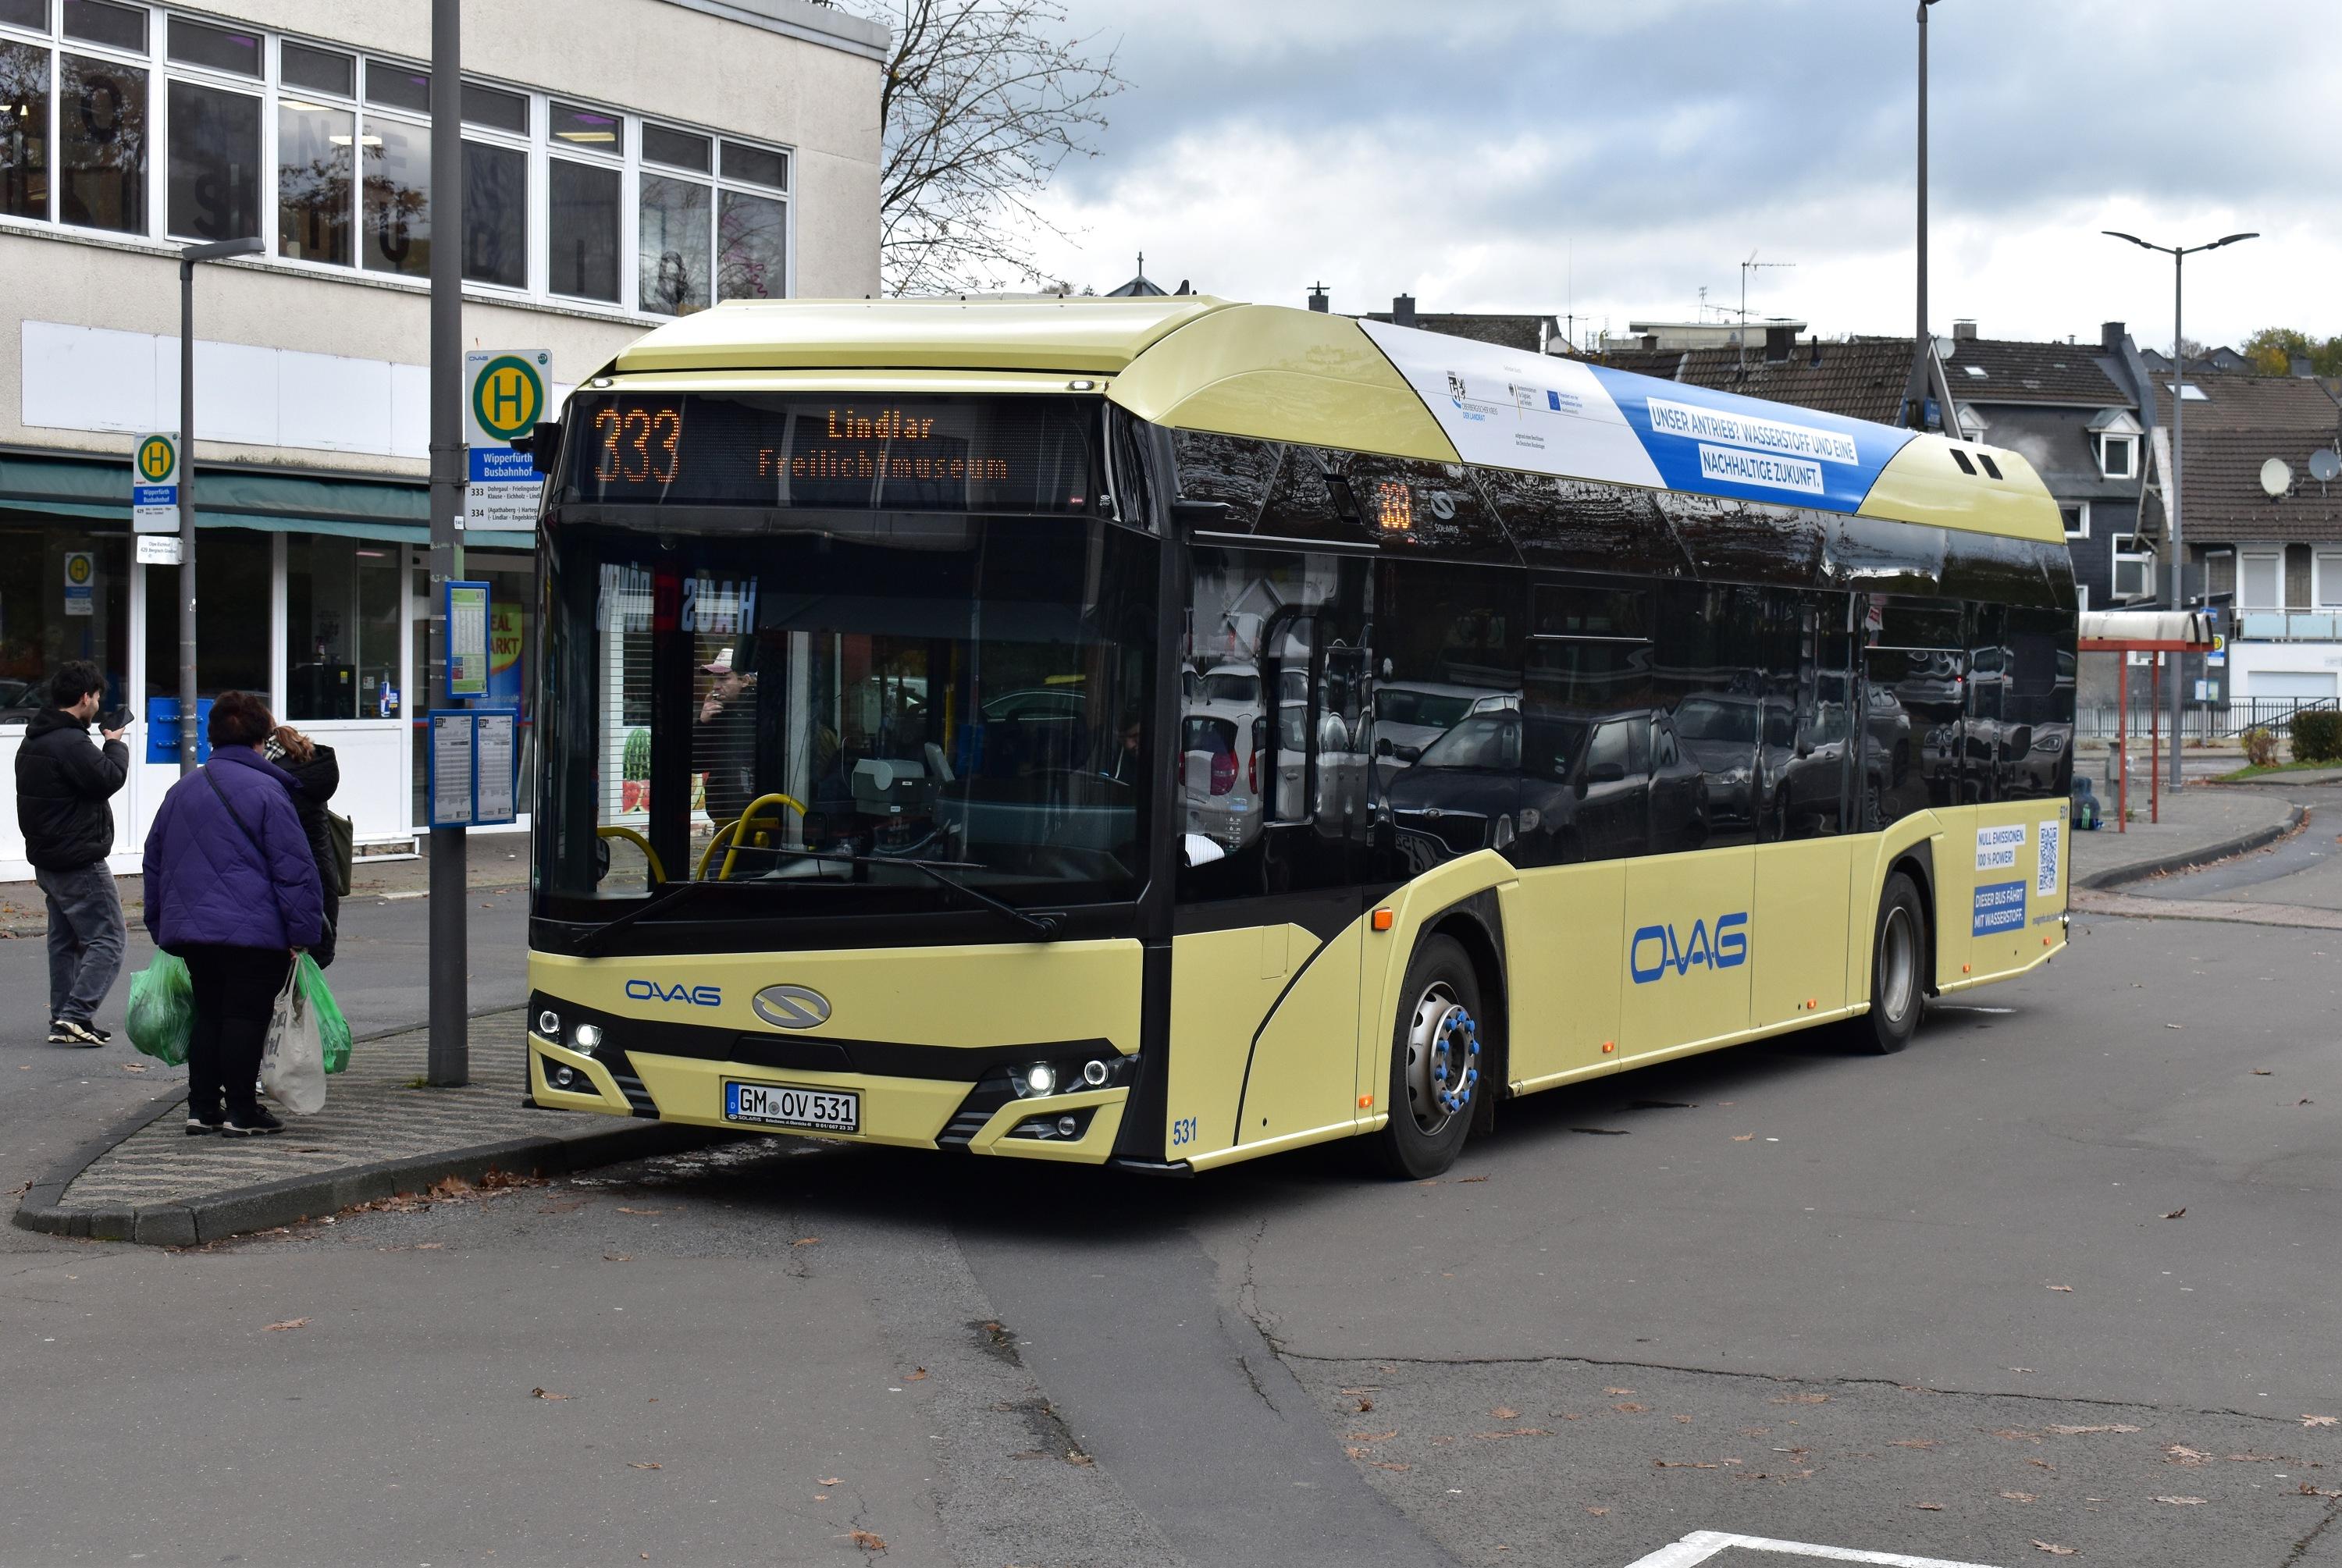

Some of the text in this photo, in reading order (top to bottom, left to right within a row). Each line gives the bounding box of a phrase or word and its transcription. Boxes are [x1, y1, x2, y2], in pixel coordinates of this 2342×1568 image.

[828, 410, 934, 439] Lindlar
[1651, 406, 1855, 460] UNSER ANTRIEB? WASSERSTOFF UND EINE
[596, 409, 679, 482] 333
[483, 453, 532, 466] Wipperfürth
[760, 450, 1007, 479] Freilichtmuseum
[1702, 451, 1821, 488] NACHHALTIGE ZUKUNFT.
[484, 467, 533, 477] Busbahnhof
[472, 488, 484, 496] 333
[472, 509, 484, 517] 334
[1379, 483, 1410, 529] 333
[1434, 524, 1459, 534] SOLARIS
[490, 614, 512, 631] EAL
[490, 638, 519, 655] ARKT
[1978, 830, 2024, 845] NULL EMISSIONEN.
[1977, 852, 1986, 866] 100
[1992, 851, 2013, 864] POWER!
[1975, 887, 2023, 908] DIESER BUS FÄHRT
[1974, 914, 1985, 928] MIT
[1985, 908, 2023, 926] WASSERSTOFF.
[1631, 911, 1748, 984] OVAG
[625, 980, 721, 1007] OVAG
[740, 1088, 767, 1114] GM
[781, 1092, 809, 1118] OV
[814, 1096, 853, 1123] 531
[1173, 1117, 1198, 1146] 531
